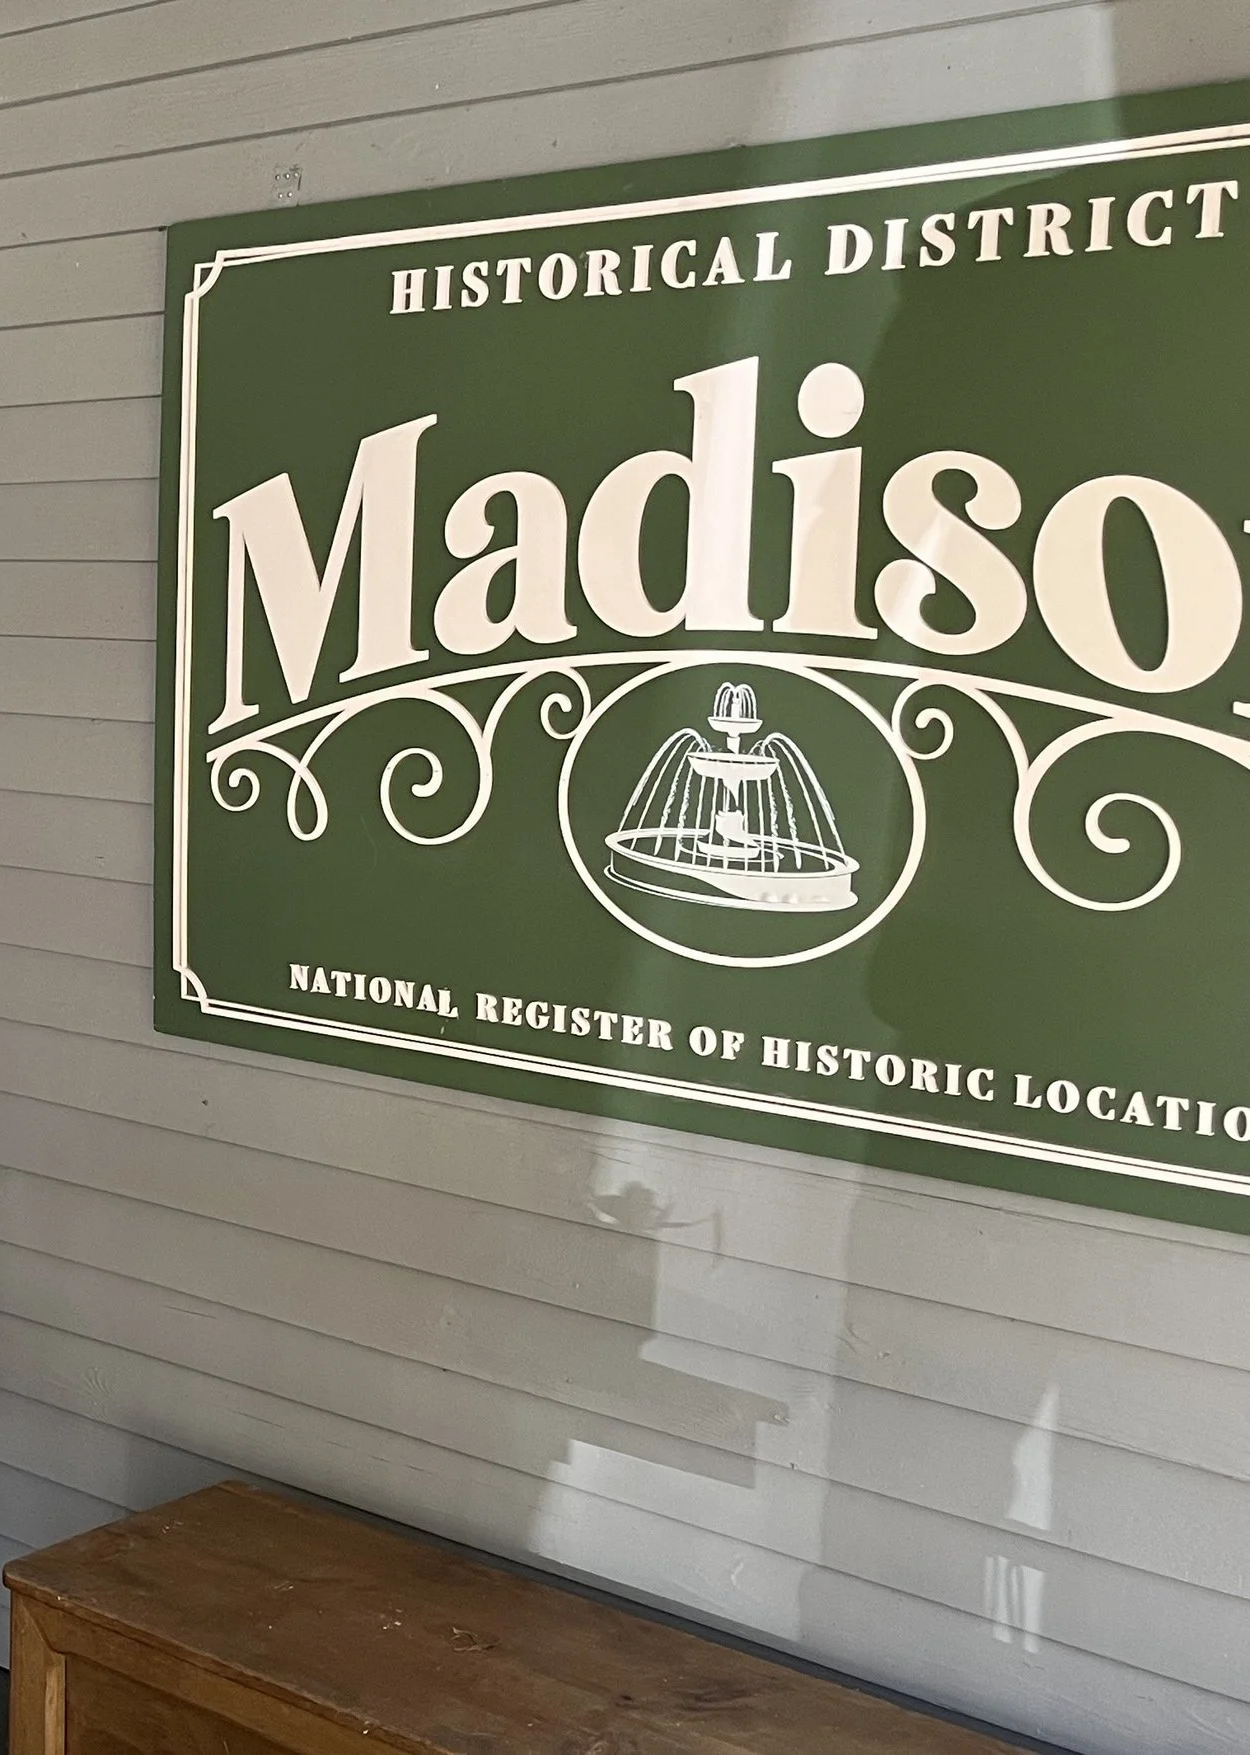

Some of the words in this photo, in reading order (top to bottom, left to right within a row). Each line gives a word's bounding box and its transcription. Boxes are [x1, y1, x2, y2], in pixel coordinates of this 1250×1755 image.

[389, 231, 792, 315] HISTORICAL
[824, 179, 1239, 276] DISTRICT
[207, 355, 1250, 735] Madiso
[289, 963, 459, 1018] NATIONAL
[475, 992, 674, 1051] REGISTER
[689, 1026, 745, 1061] OF
[761, 1035, 995, 1102] HISTORIC
